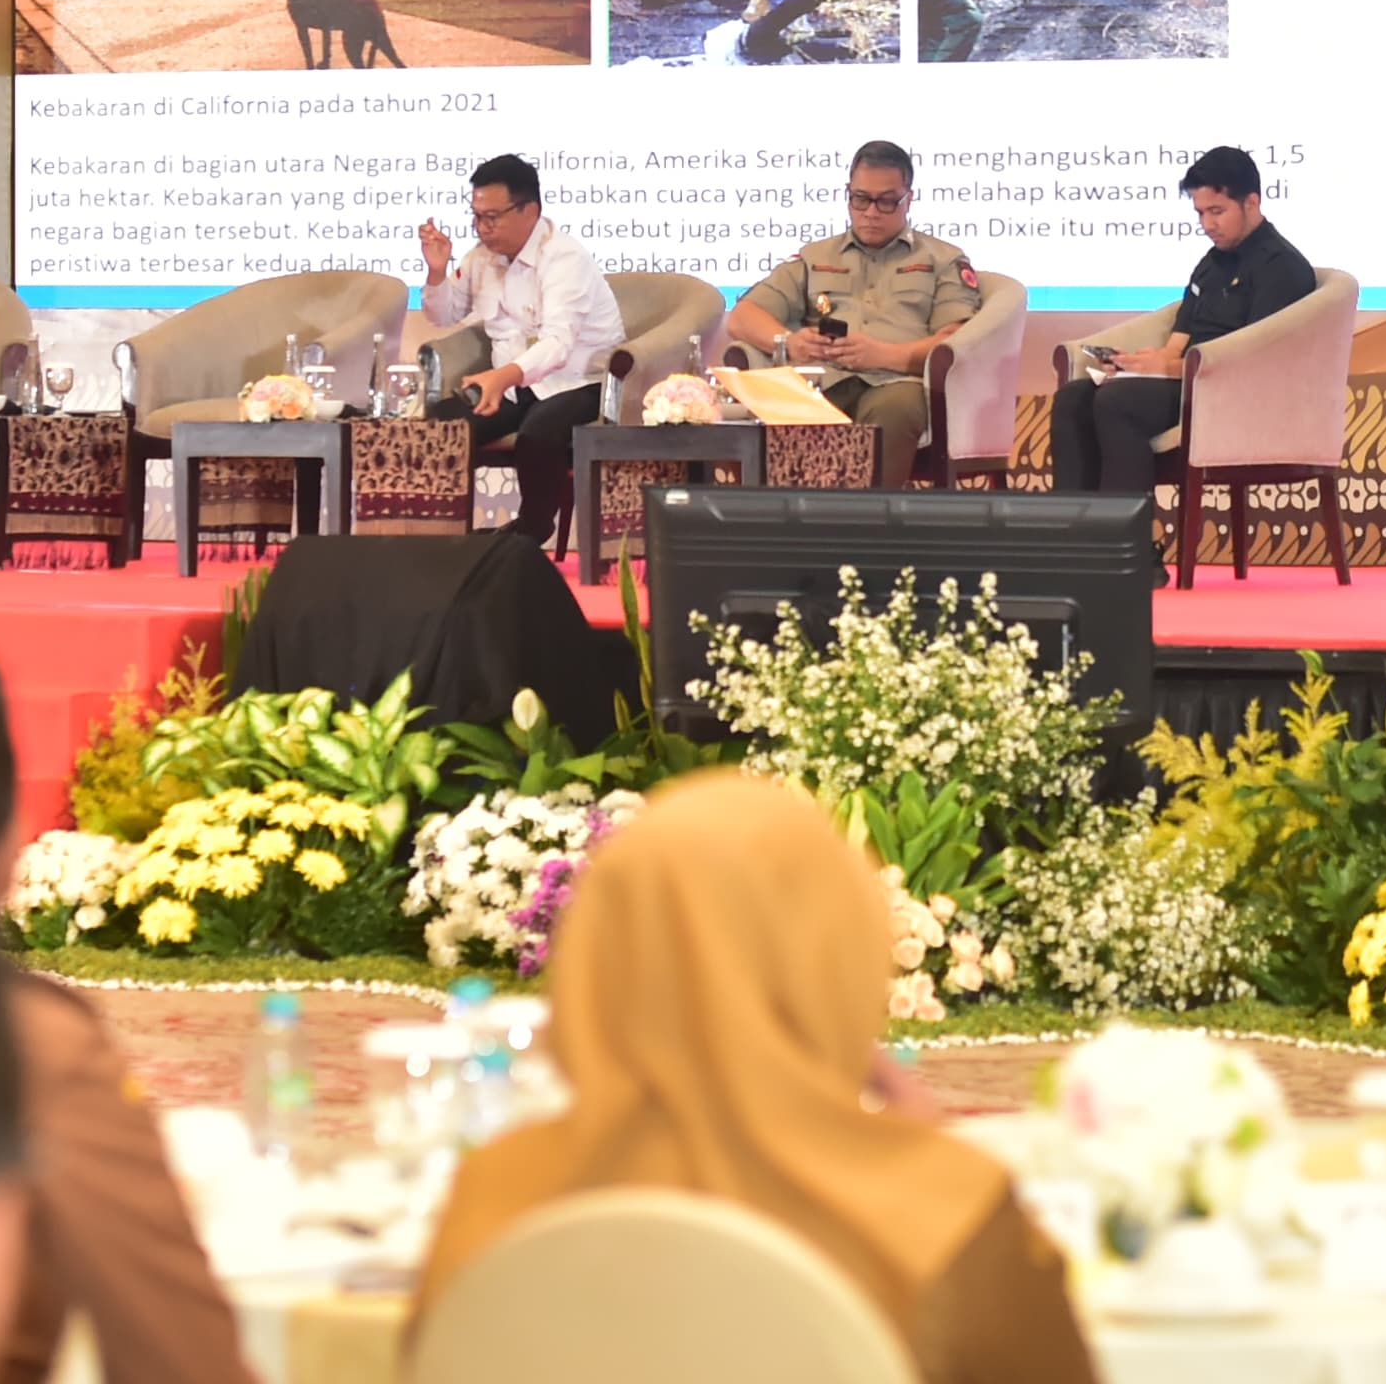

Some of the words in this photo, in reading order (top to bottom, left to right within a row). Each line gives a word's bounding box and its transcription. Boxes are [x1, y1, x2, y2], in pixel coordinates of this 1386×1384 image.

[30, 98, 145, 118] Kebakaran
[154, 97, 173, 116] di
[181, 95, 290, 116] California
[299, 96, 355, 118] pada
[364, 93, 431, 113] tahun
[441, 92, 498, 112] 2021
[30, 156, 145, 176] Kebakaran
[154, 155, 173, 174] di
[182, 155, 256, 178] bagian
[266, 156, 325, 173] utara
[334, 154, 416, 177] Negara
[644, 149, 747, 169] Amerika
[756, 148, 850, 171] Serikat,
[933, 145, 1148, 173] menghanguskan
[1266, 144, 1305, 168] 1,5
[28, 190, 70, 213] juta
[79, 188, 154, 207] hektar.
[164, 187, 283, 207] Kebakaran
[291, 191, 345, 211] yang
[656, 188, 726, 204] cuaca
[735, 188, 794, 209] yang
[932, 181, 1044, 207] melahap
[1054, 180, 1167, 201] kawasan
[1265, 179, 1289, 200] di
[30, 226, 104, 246] negara
[112, 221, 186, 245] bagian
[194, 220, 298, 240] tersebut.
[307, 220, 414, 240] Kebakara
[580, 218, 671, 239] disebut
[679, 218, 731, 244] juga
[740, 216, 834, 243] sebagai
[988, 217, 1051, 238] Dixie
[1061, 217, 1094, 237] itu
[1105, 218, 1205, 241] merupa
[30, 254, 131, 277] peristiwa
[140, 253, 235, 273] terbesar
[243, 252, 312, 273] kedua
[320, 252, 391, 272] dalam
[727, 252, 748, 273] di
